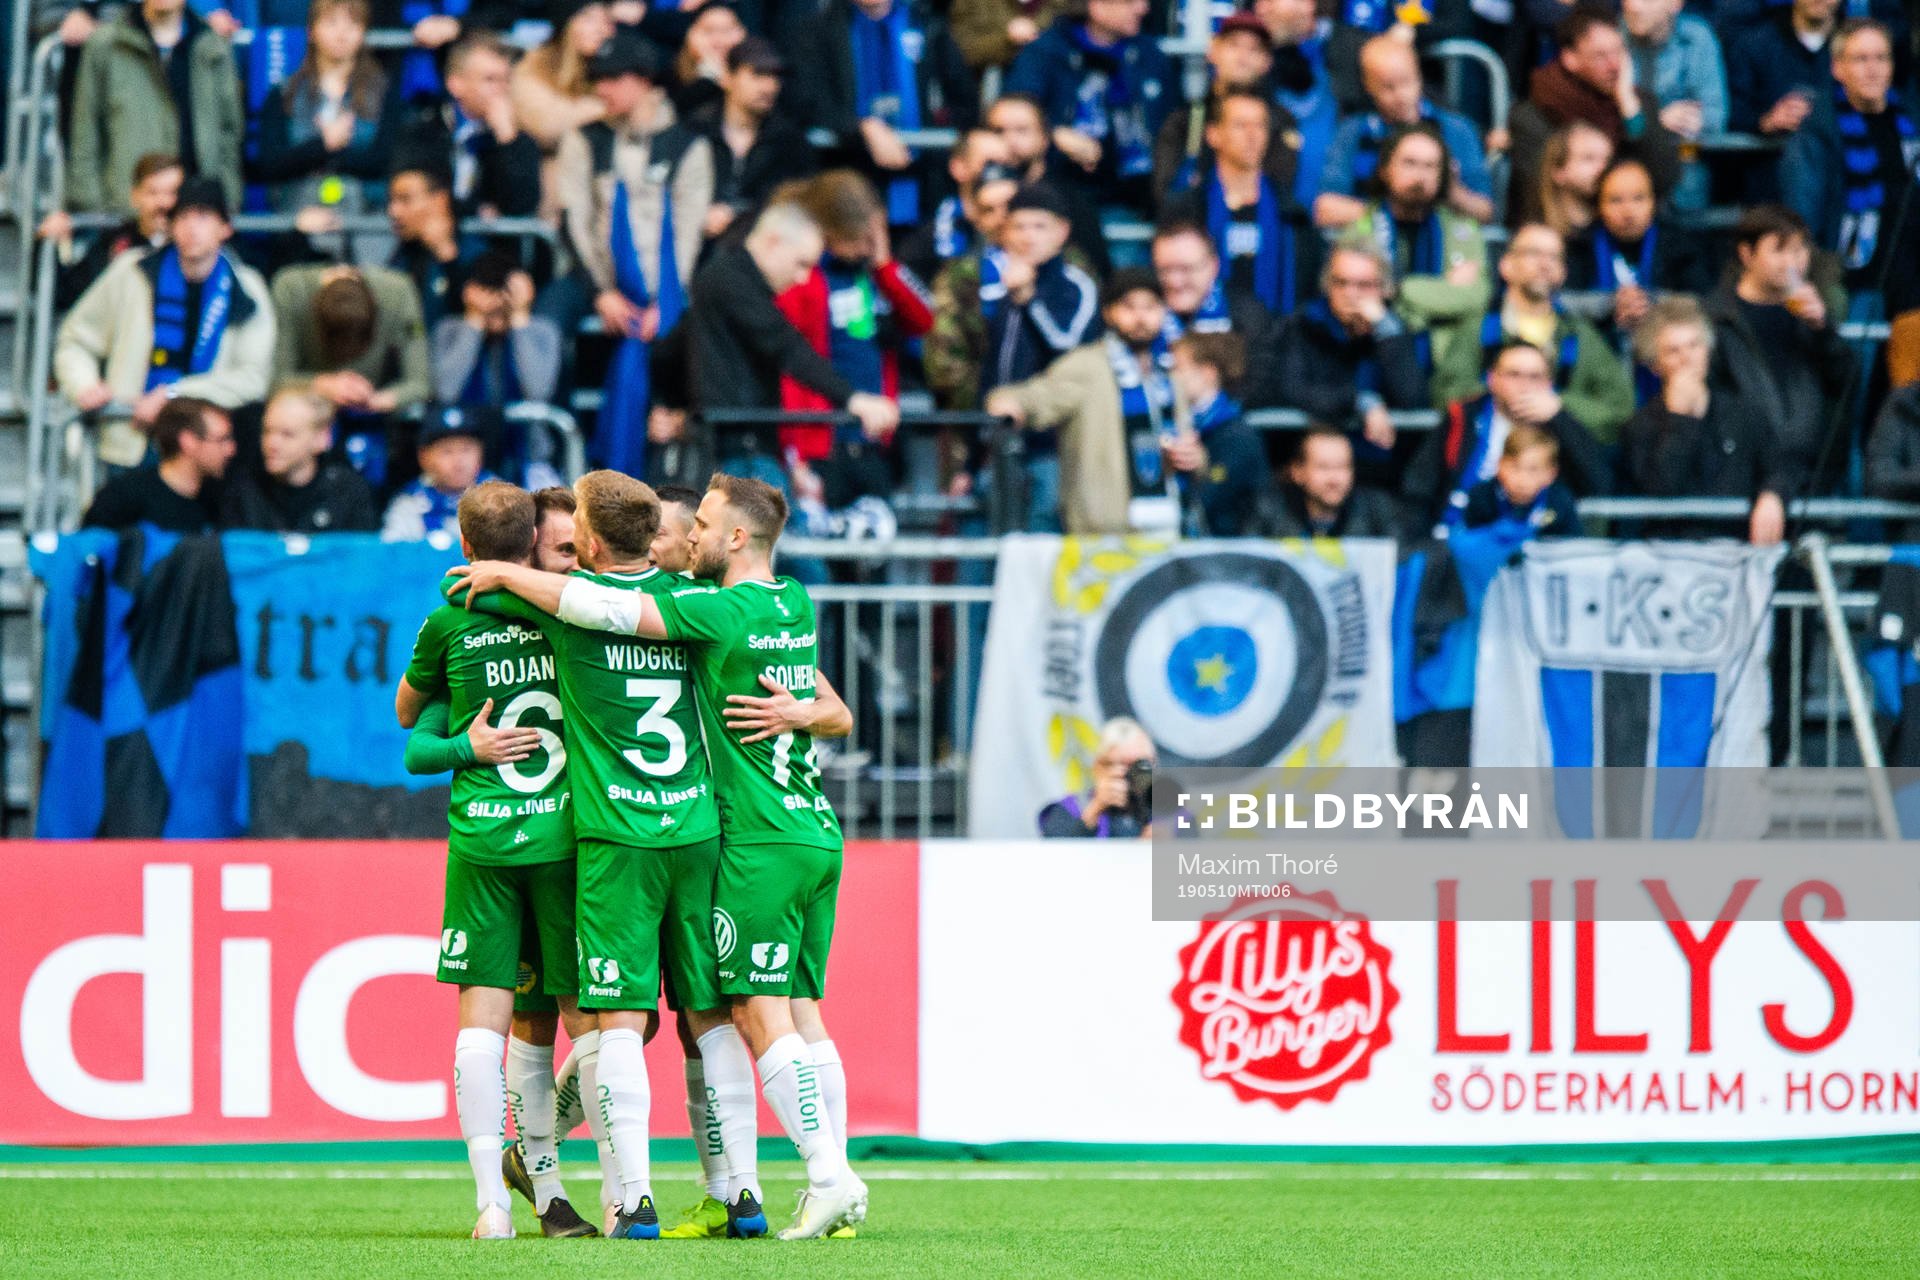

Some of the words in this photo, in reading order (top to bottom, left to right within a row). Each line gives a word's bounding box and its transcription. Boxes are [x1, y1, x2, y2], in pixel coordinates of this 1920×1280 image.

[464, 632, 511, 649] Sefina
[485, 655, 555, 687] BOJAN
[497, 690, 566, 793] 6
[622, 678, 688, 777] 3
[467, 801, 512, 818] SILJA
[607, 784, 657, 805] SILJA
[661, 786, 699, 805] LINE
[19, 863, 448, 1122] dic
[749, 970, 788, 983] fronta
[1189, 912, 1366, 1016] Lily's
[1434, 879, 1854, 1053] LILYS
[1203, 985, 1383, 1078] Burger
[1431, 1063, 1745, 1112] SÖDERMALM
